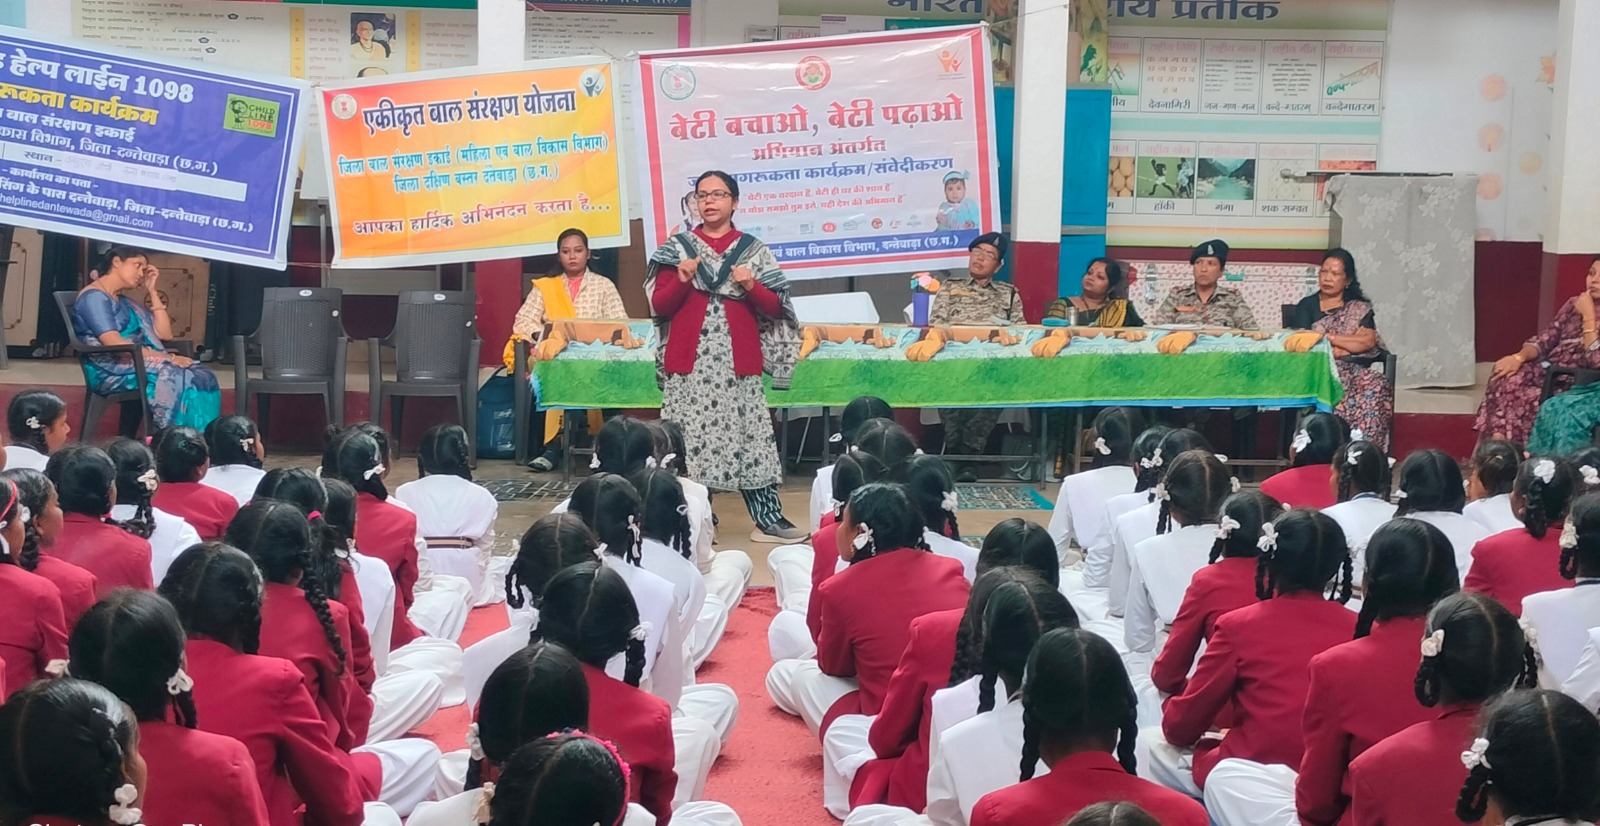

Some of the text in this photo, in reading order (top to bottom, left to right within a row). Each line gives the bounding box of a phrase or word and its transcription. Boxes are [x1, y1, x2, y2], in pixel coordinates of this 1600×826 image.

[10, 48, 60, 79] हेल्प
[64, 64, 130, 91] लाईन
[133, 75, 194, 103] 1098
[70, 95, 159, 125] कार्यक्रम
[249, 104, 276, 115] CHILD
[250, 112, 274, 124] LINE
[363, 84, 576, 136] एकीकृत बाल संरक्षण योजना
[669, 92, 964, 140] बेटी बचाओ, बेटी पढ़ाओ
[41, 112, 92, 133] संरक्षण
[94, 124, 136, 143] इकाई
[248, 119, 272, 130] 1098
[24, 150, 54, 163] स्थान
[31, 128, 75, 150] विभाग,
[173, 155, 218, 176] (छ.ग.)
[338, 156, 364, 175] जिला
[392, 150, 423, 169] संरक्षण
[456, 143, 491, 166] (महिला
[536, 136, 569, 155] विकास
[572, 132, 609, 153] विभाग)
[751, 135, 887, 160] अभियान अंतर्गत
[10, 165, 53, 182] कार्यालय
[55, 174, 69, 186] का
[72, 178, 91, 189] पता
[393, 173, 419, 192] जिला
[422, 169, 451, 189] दक्षिण
[26, 181, 40, 194] के
[42, 186, 67, 200] पास
[213, 217, 254, 232] (छ.ग.)
[354, 219, 404, 234] आपका
[409, 210, 454, 230] हार्दिक
[462, 201, 527, 224] अभिनंदन
[534, 199, 573, 213] करता
[1154, 199, 1175, 211] हॉकी
[809, 242, 842, 256] विकास
